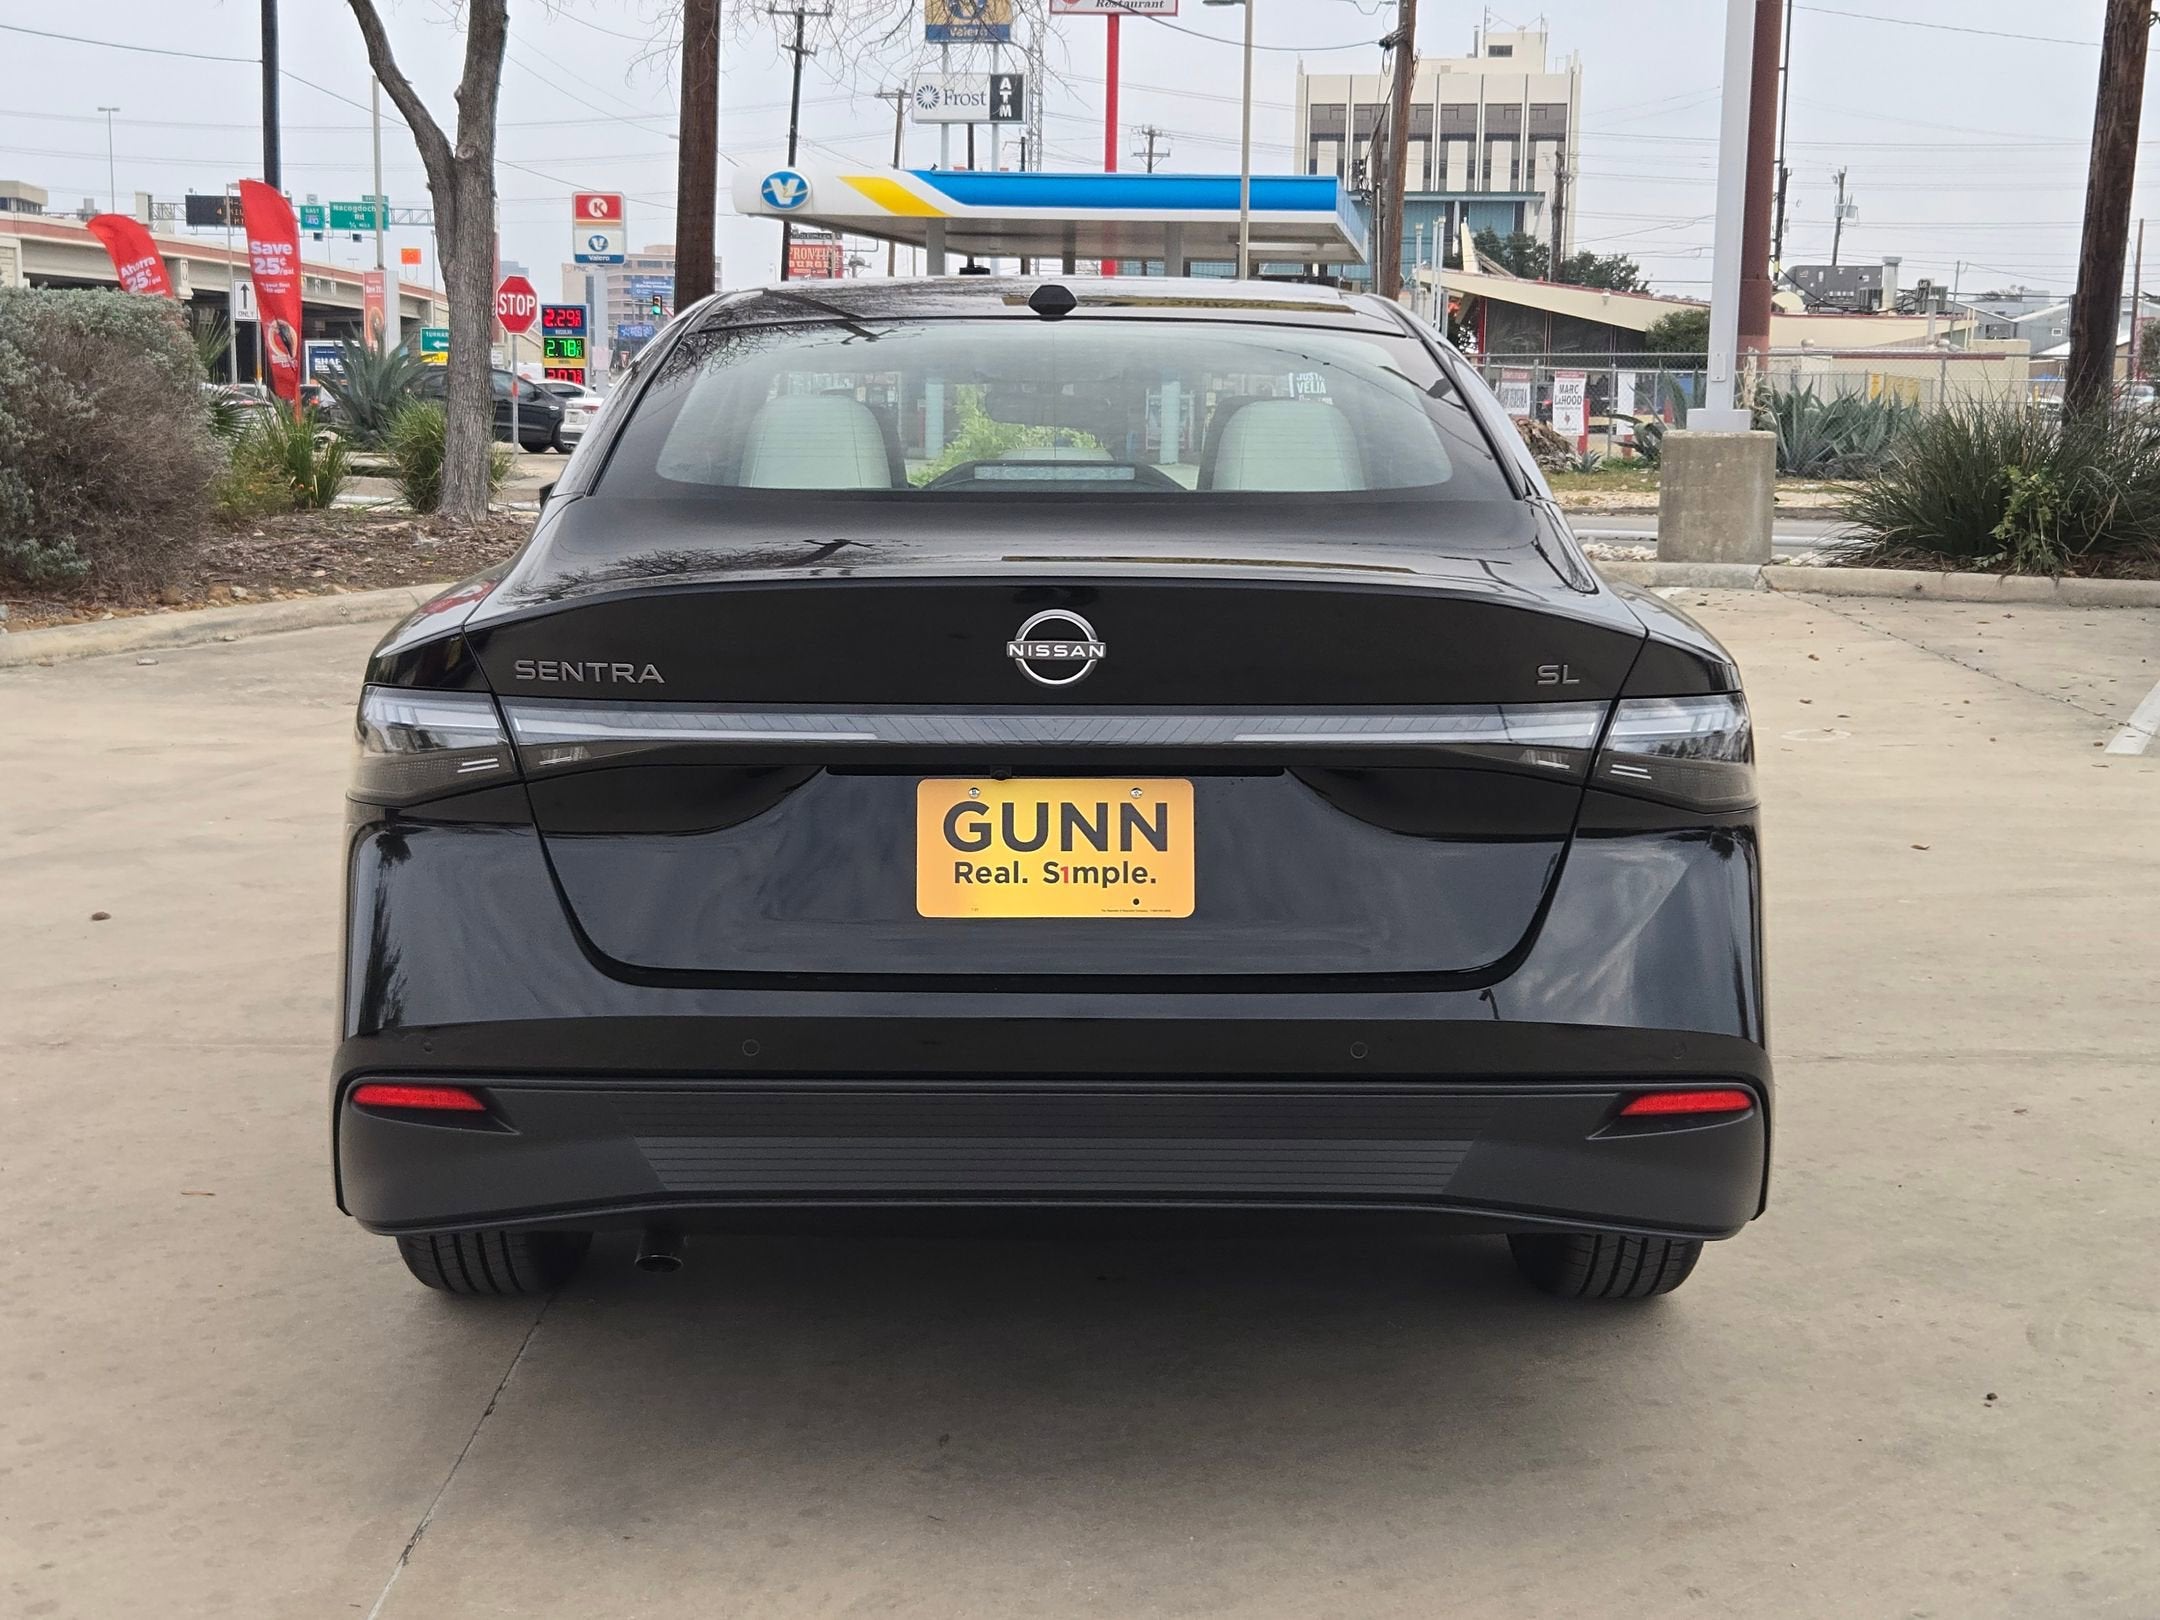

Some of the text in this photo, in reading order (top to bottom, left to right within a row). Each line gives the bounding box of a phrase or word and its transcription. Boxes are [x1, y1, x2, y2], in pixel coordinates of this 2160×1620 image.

[943, 89, 988, 106] Frost
[999, 77, 1012, 118] ATM
[333, 204, 386, 213] Nacogdochs
[251, 240, 293, 255] Save
[588, 254, 610, 262] Valero
[121, 256, 157, 278] Ahorra
[498, 293, 536, 316] STOP
[1559, 384, 1580, 395] MARC
[1009, 644, 1104, 658] NISSAN
[514, 660, 665, 684] SENTRA
[1537, 664, 1580, 685] SL
[943, 800, 1168, 853] GUNN
[954, 861, 1028, 884] Real.
